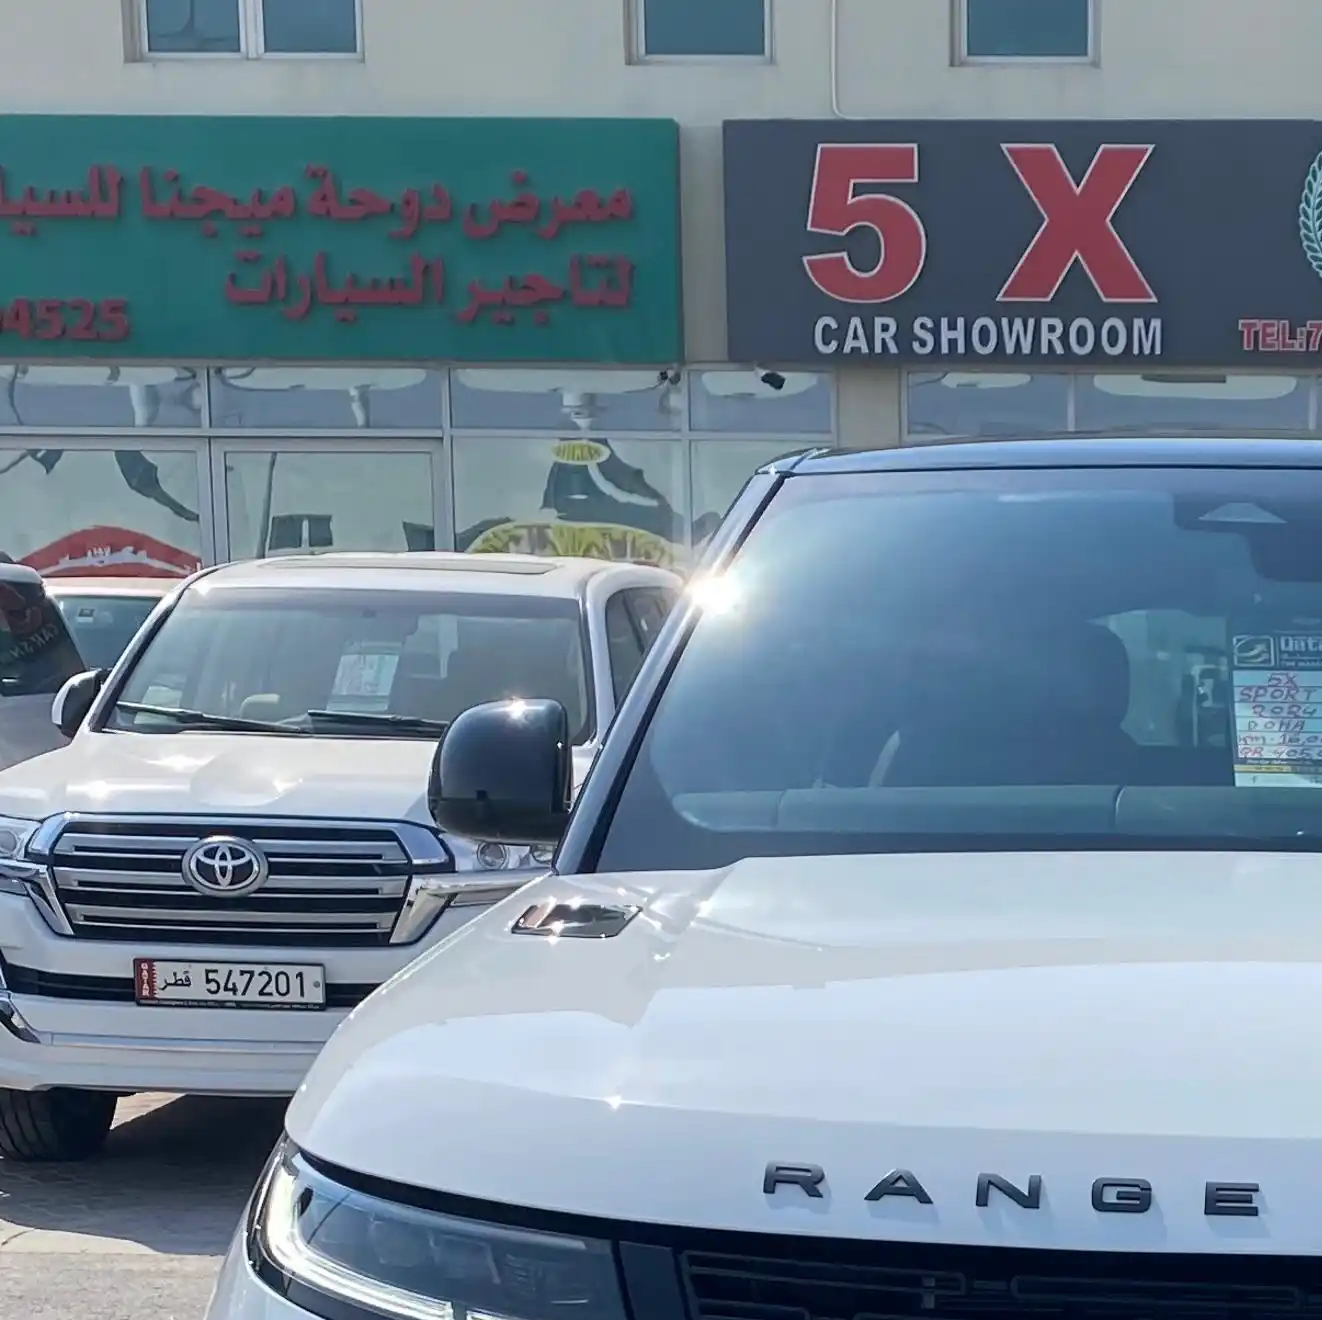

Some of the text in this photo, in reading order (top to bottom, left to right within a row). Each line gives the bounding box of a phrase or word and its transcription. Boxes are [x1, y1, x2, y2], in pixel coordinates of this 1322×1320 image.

[305, 164, 452, 240] دوحة
[462, 168, 633, 239] معرض
[802, 142, 1159, 304] 5 X
[225, 251, 444, 323] السيارات
[0, 298, 130, 341] 4525
[814, 316, 1162, 356] CAR SHOWROOM
[1239, 686, 1317, 702] SPORT
[1251, 704, 1318, 717] 2024
[1247, 719, 1305, 733] DOHA
[158, 969, 192, 991] قطر
[205, 968, 305, 998] 547201
[763, 1161, 1260, 1217] RANGE
